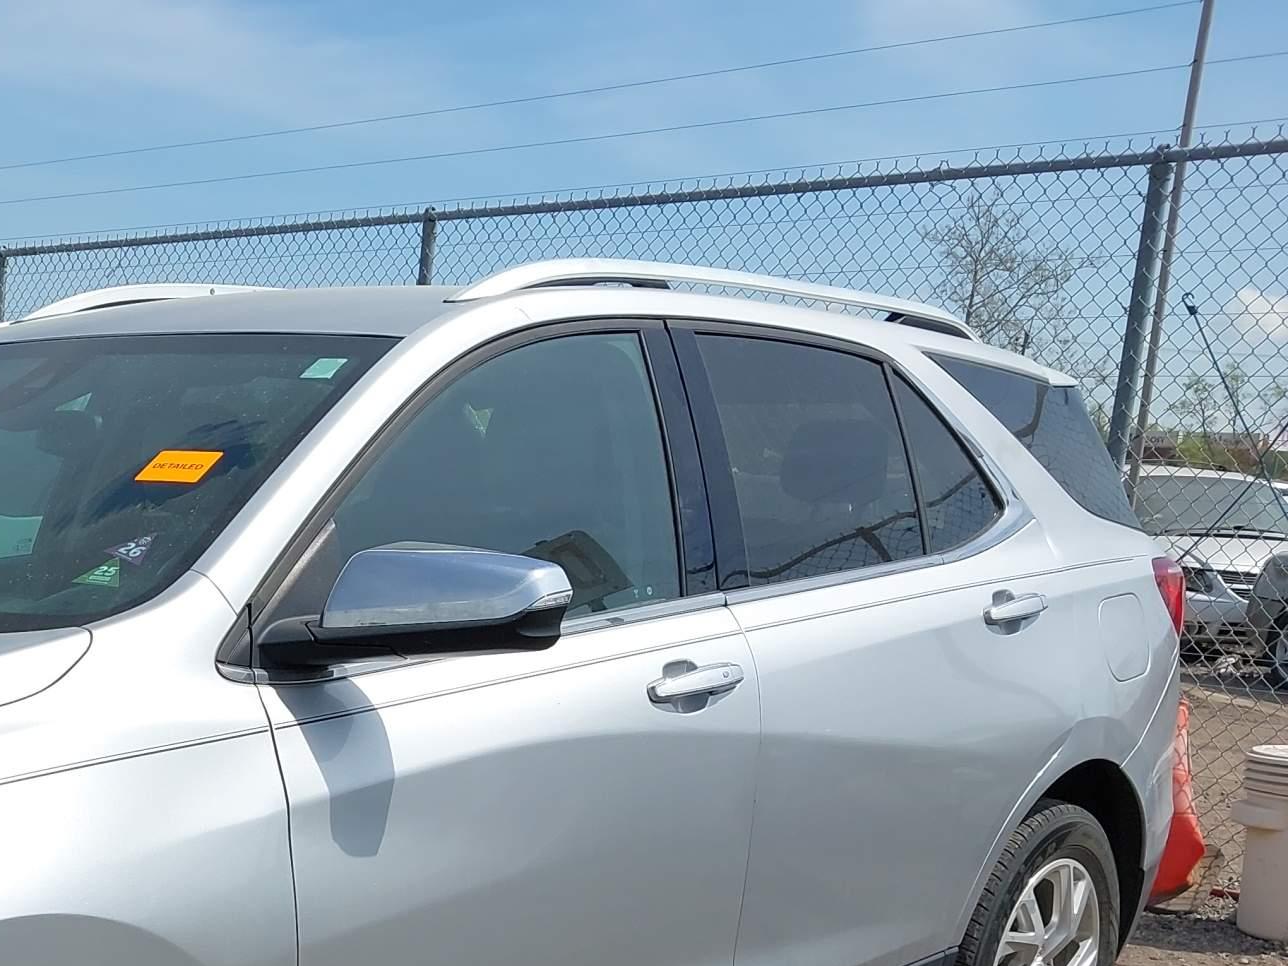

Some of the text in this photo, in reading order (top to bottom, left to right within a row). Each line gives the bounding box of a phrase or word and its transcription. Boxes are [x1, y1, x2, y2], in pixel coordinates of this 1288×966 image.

[152, 462, 205, 470] DETAILED
[117, 542, 147, 557] 26
[93, 565, 120, 576] 25
